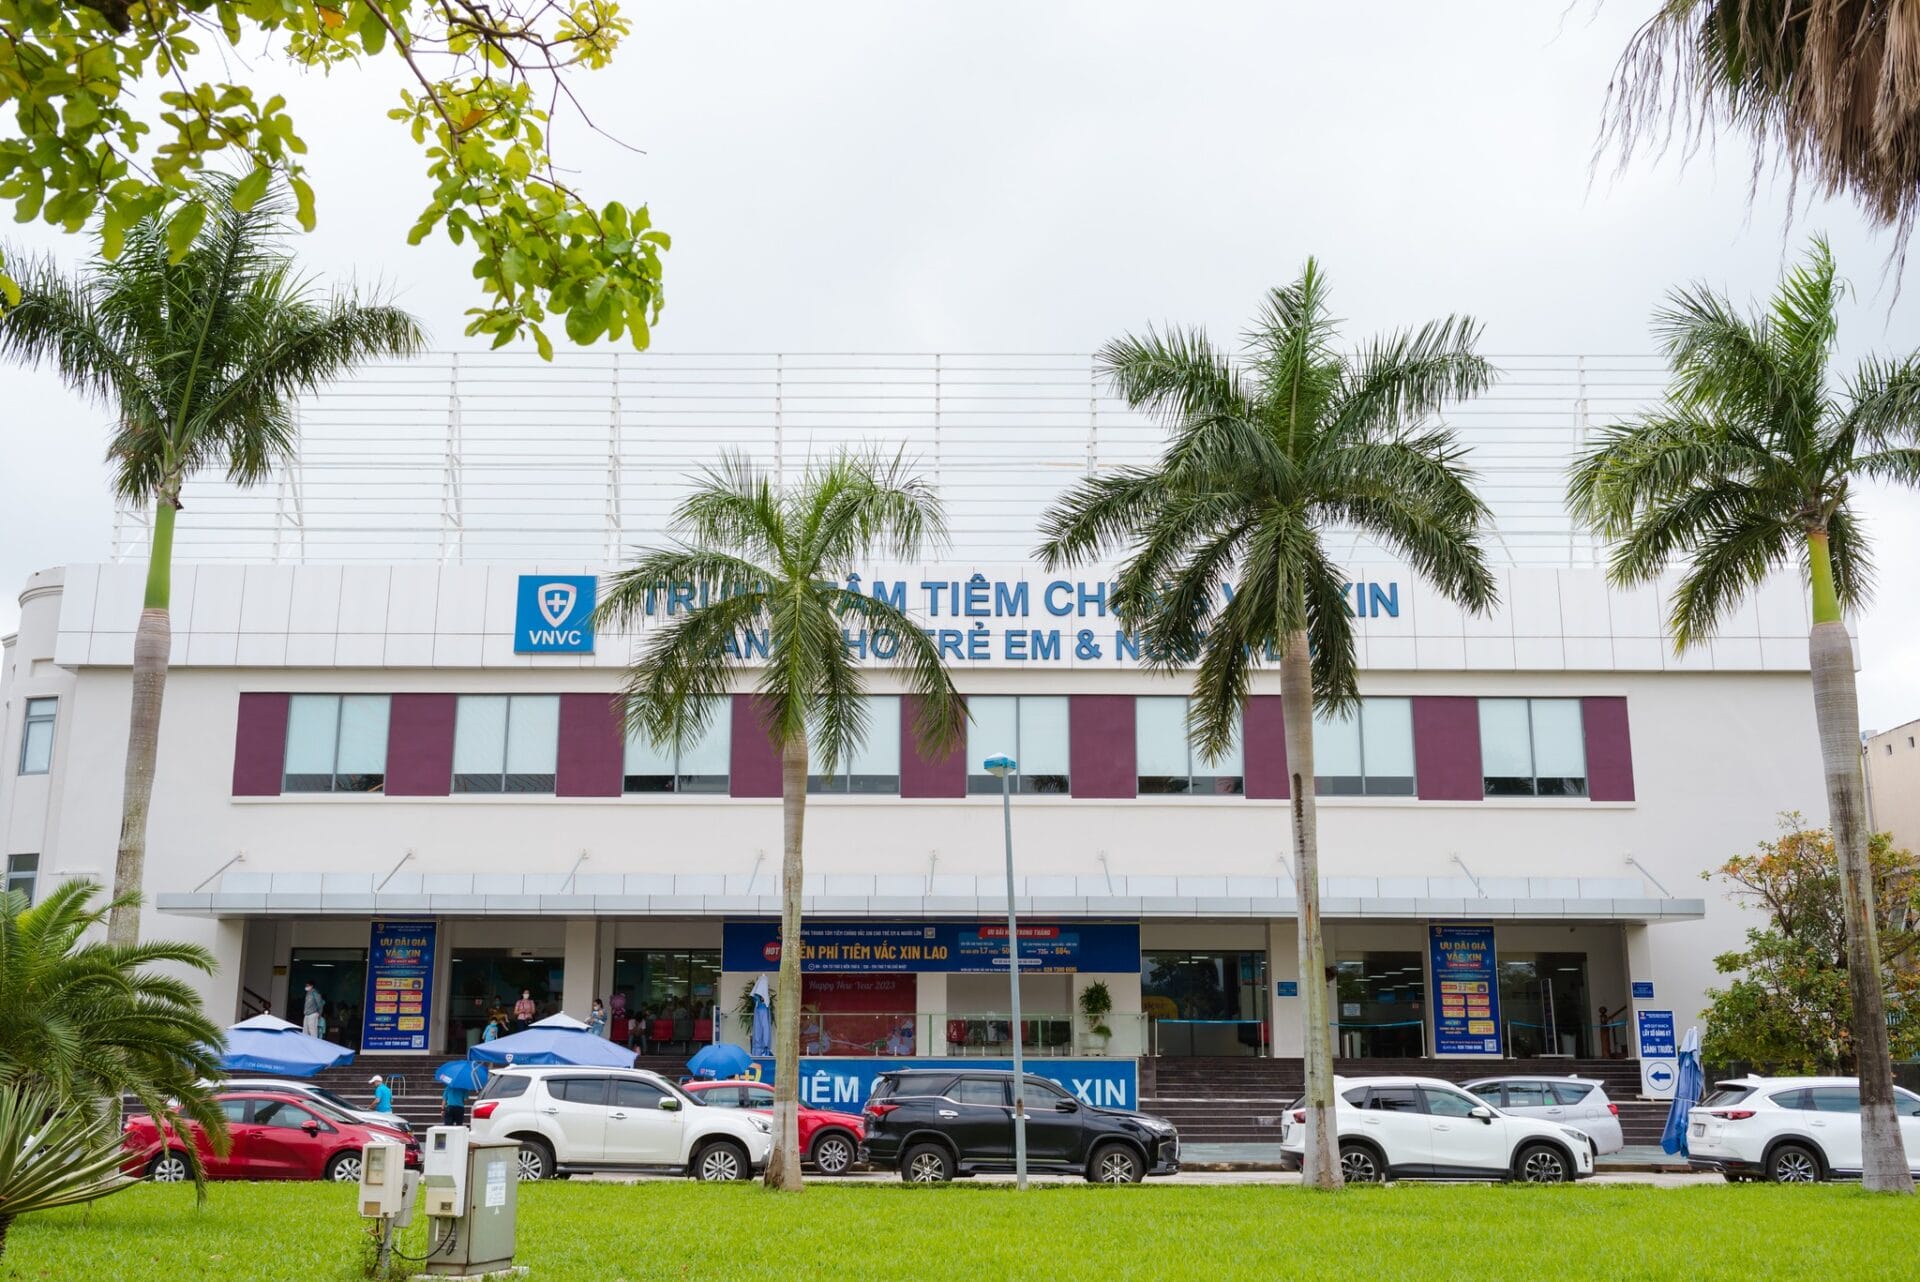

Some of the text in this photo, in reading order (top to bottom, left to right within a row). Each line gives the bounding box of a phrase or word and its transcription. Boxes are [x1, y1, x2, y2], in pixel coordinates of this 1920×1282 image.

[921, 573, 1029, 617] TIÊM
[528, 629, 582, 646] VNVC
[842, 628, 899, 660] HO
[1005, 629, 1060, 660] EM
[1075, 629, 1103, 660] &
[765, 946, 780, 956] HOT
[818, 943, 839, 960] PHÍ
[842, 943, 871, 960] TIÊM
[874, 940, 897, 960] VẮC
[900, 945, 921, 960] XIN
[924, 945, 948, 960] LAO
[808, 981, 834, 991] Happy
[802, 1069, 859, 1103] IÊM
